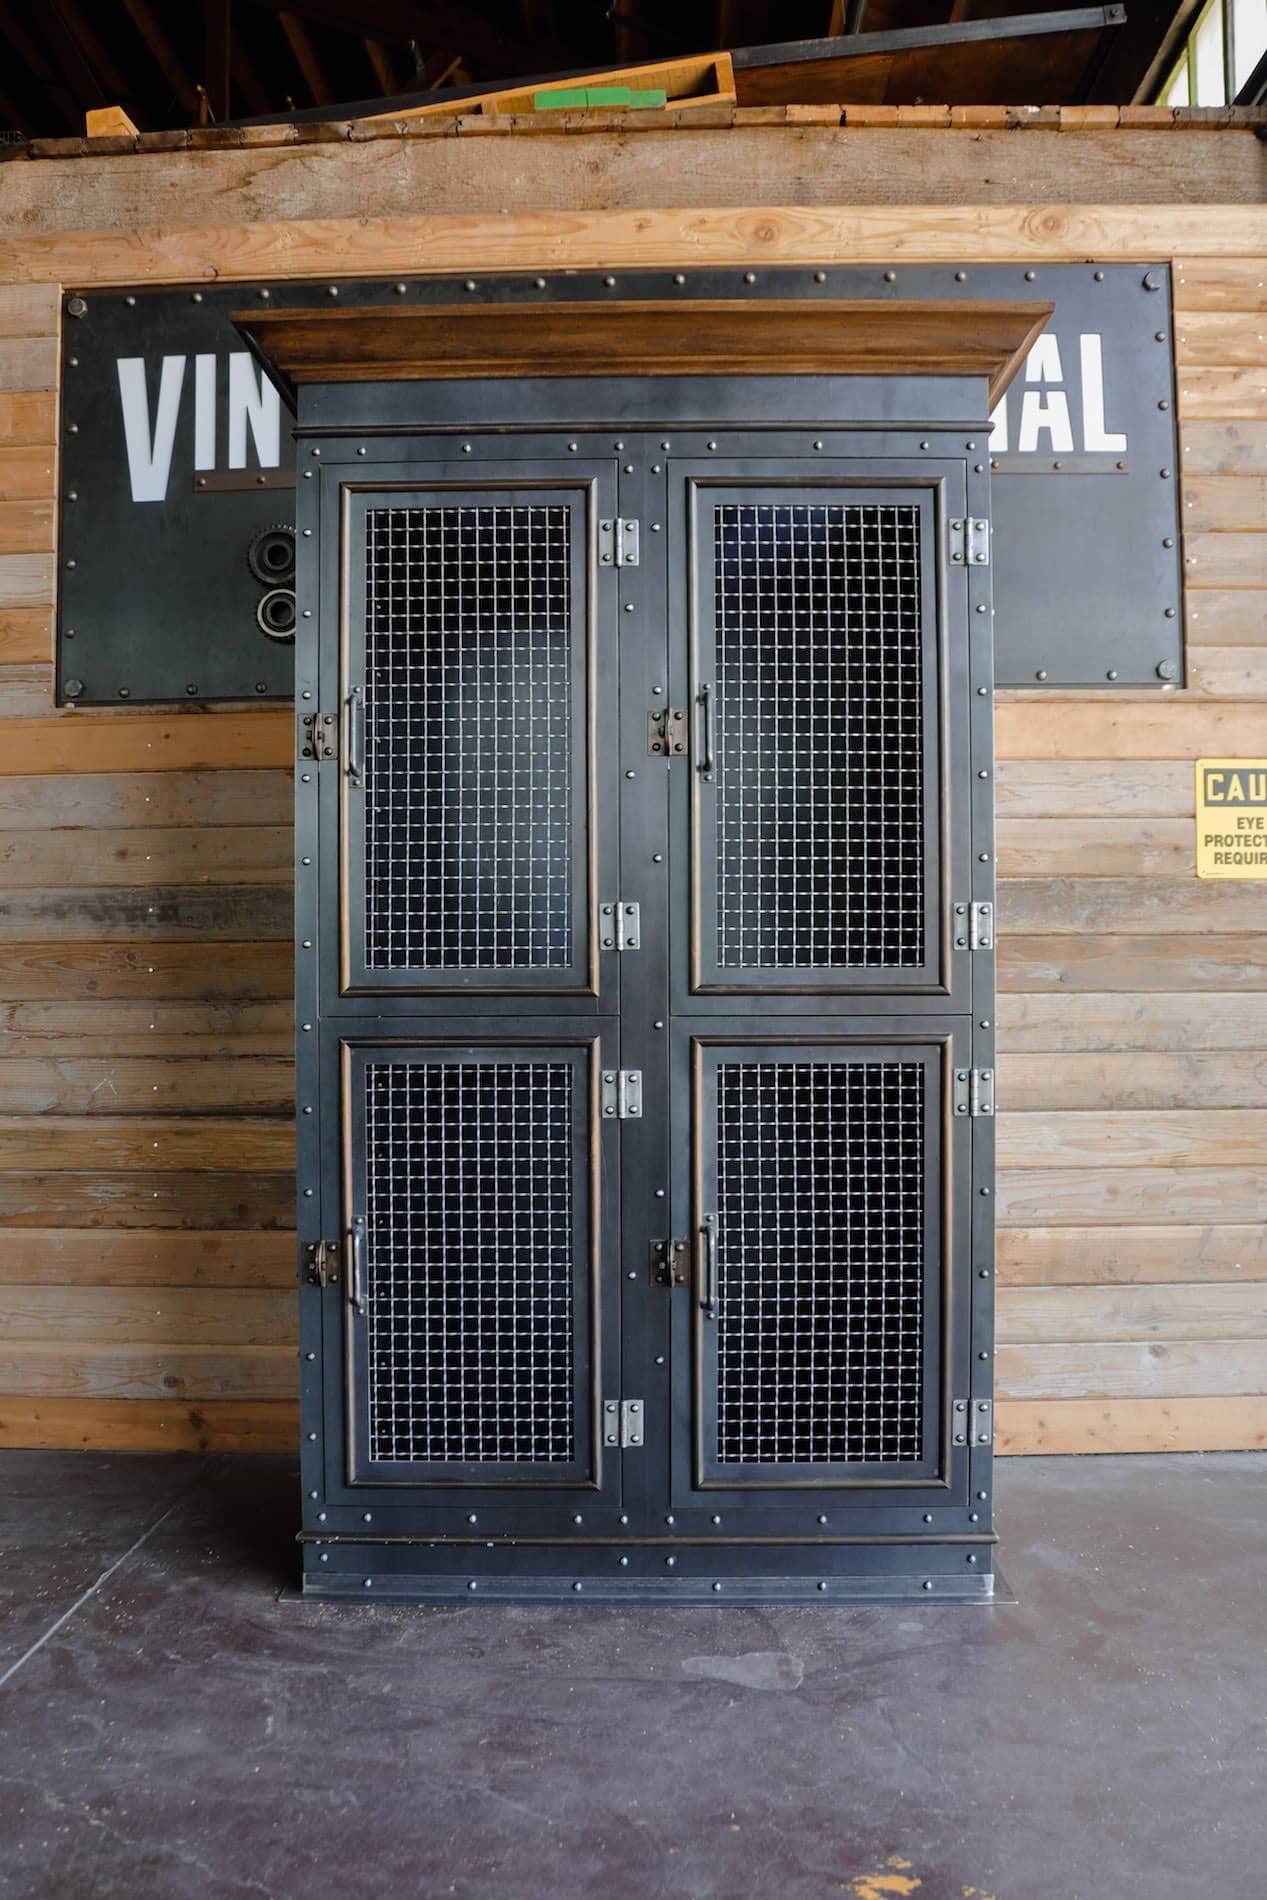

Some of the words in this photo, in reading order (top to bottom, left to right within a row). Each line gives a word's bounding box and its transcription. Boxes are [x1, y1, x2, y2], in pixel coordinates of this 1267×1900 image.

[116, 352, 281, 502] VIN
[1207, 773, 1267, 801] CAU
[1236, 817, 1264, 830] EYE
